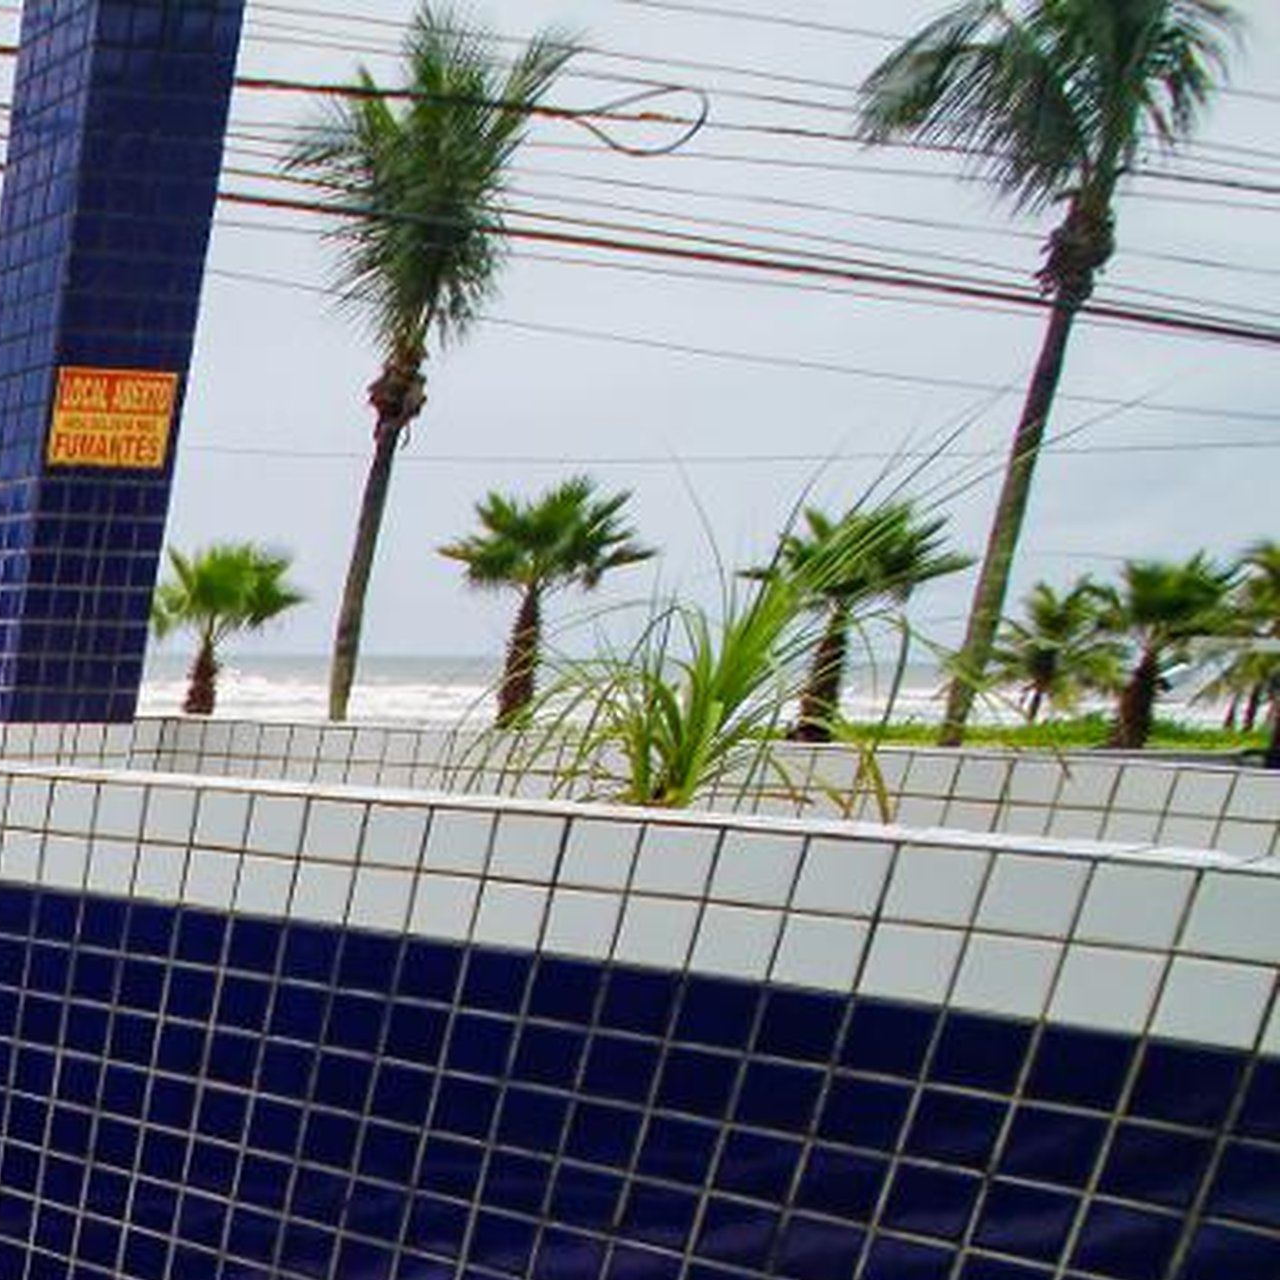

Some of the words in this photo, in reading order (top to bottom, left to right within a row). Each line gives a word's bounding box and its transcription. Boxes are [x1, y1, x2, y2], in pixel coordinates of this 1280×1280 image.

[61, 377, 108, 409] LOCAL
[113, 380, 169, 412] ABERTO
[53, 433, 160, 462] FUMANTES
